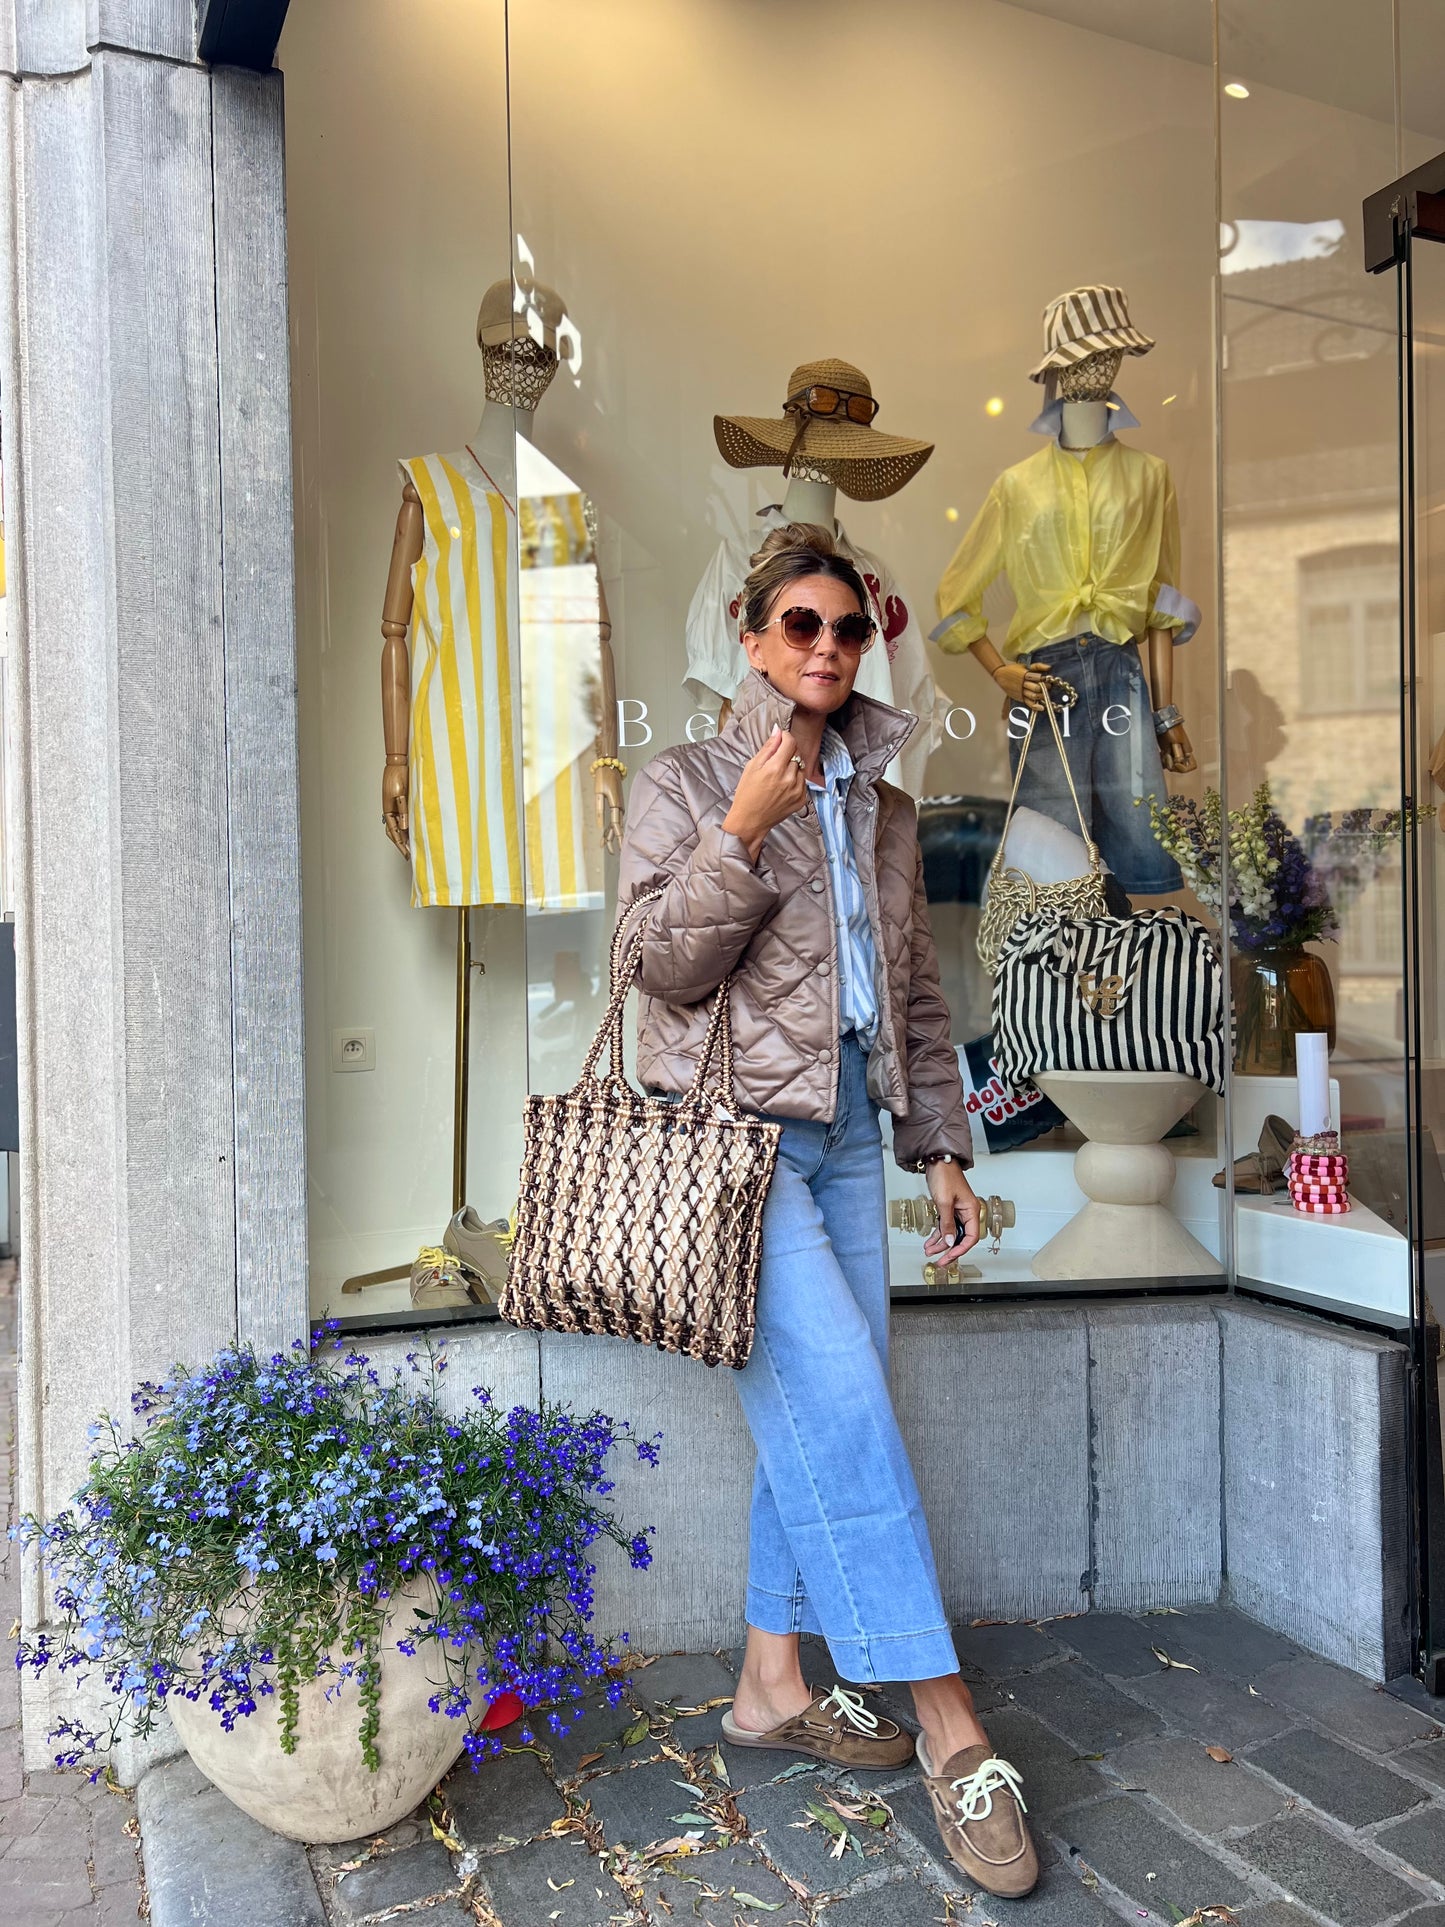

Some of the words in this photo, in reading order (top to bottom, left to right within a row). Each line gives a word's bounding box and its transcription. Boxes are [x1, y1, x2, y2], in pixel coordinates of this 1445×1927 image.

[616, 694, 1132, 747] Beosie
[965, 1078, 1005, 1114] dol
[987, 1091, 1041, 1122] vita
